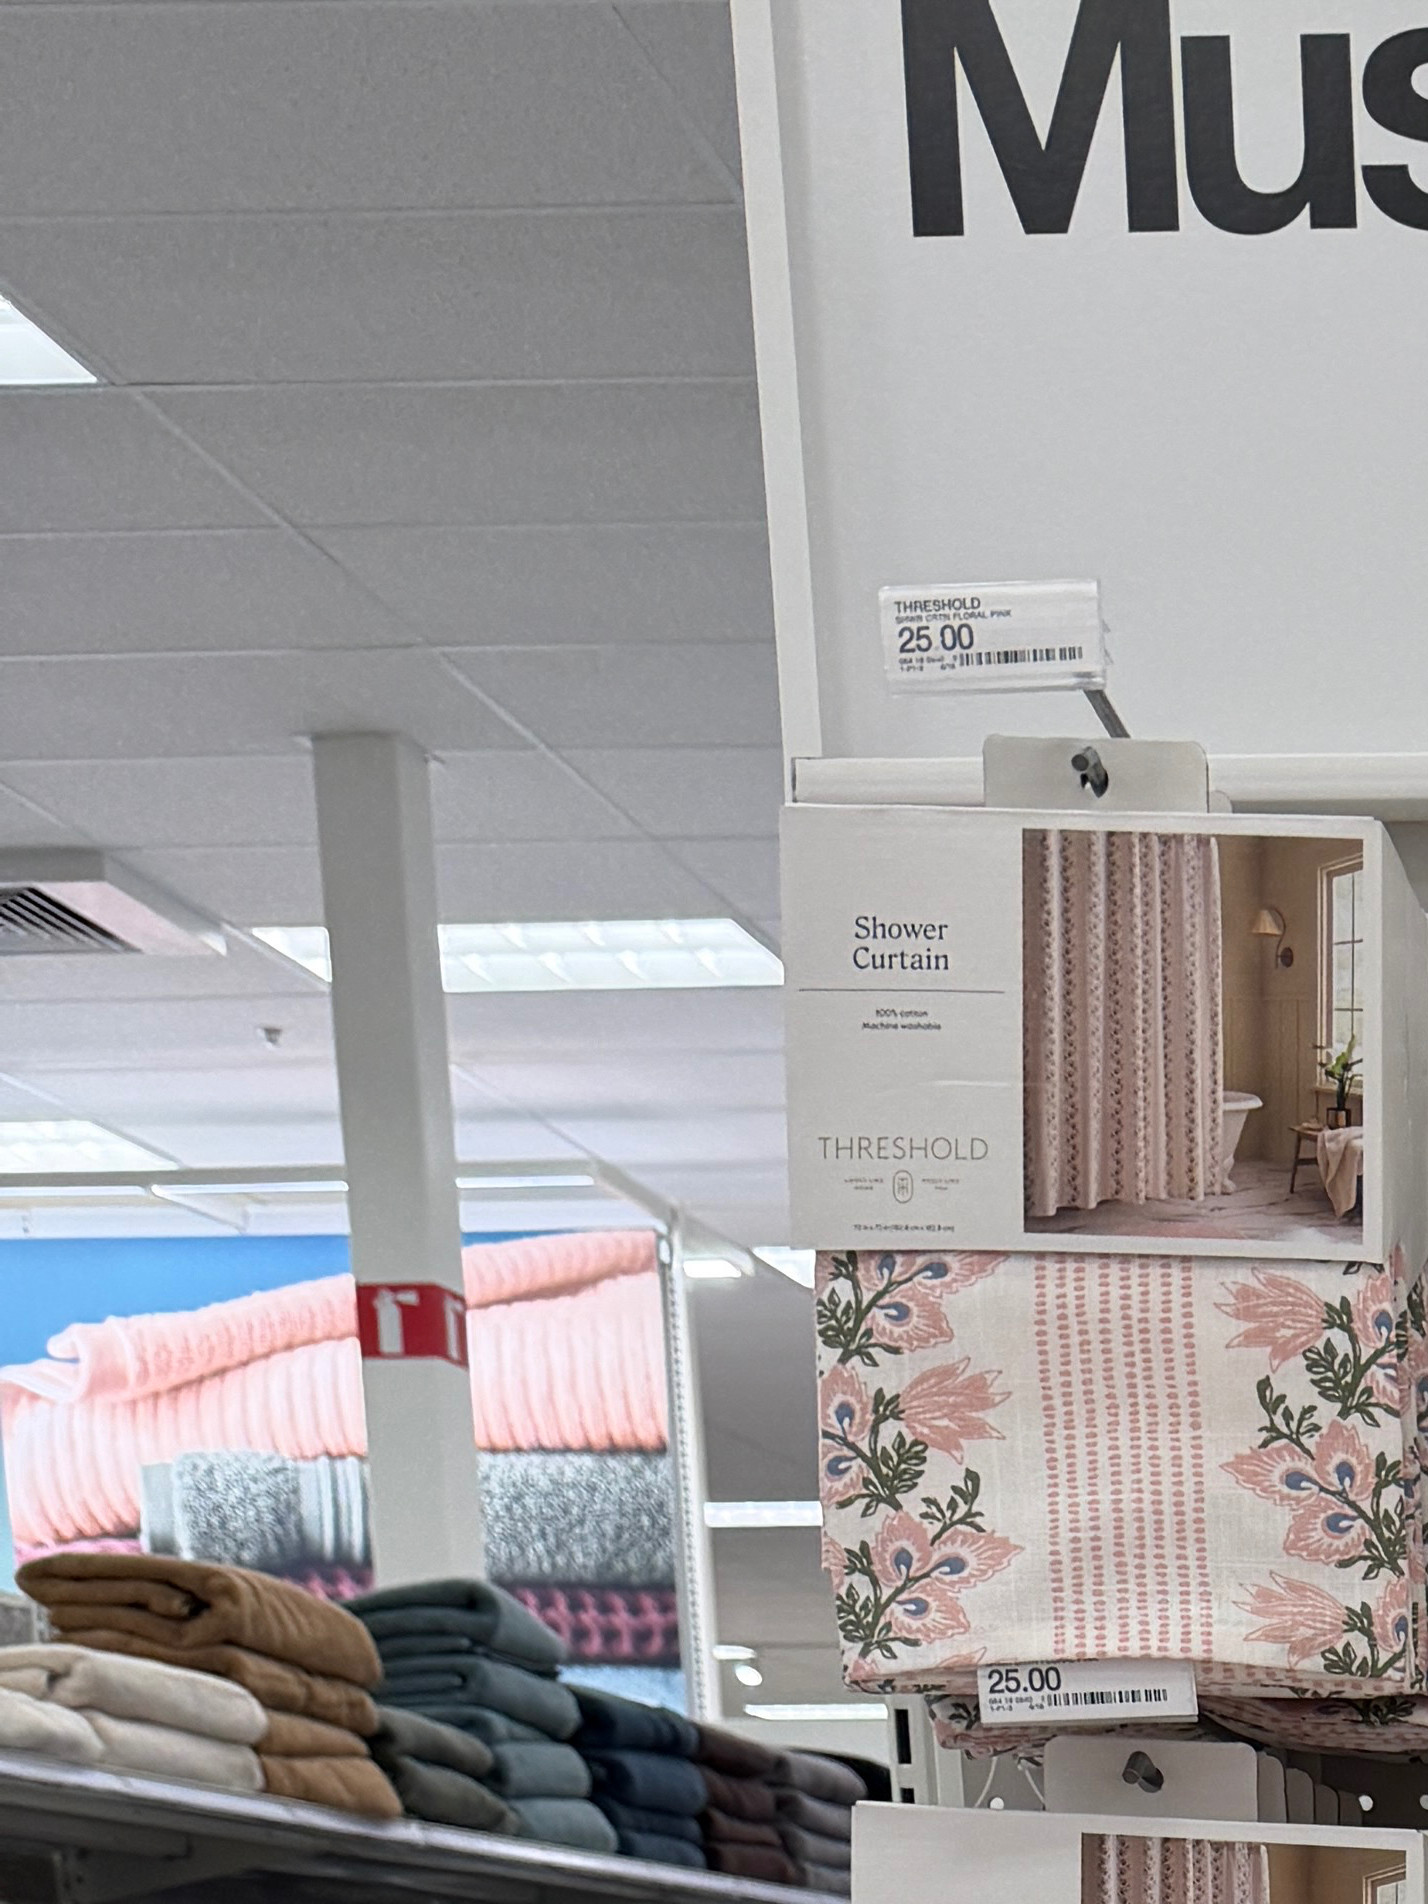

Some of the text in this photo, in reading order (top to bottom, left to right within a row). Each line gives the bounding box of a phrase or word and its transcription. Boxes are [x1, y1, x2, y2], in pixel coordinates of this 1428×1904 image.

[894, 597, 981, 613] THRESHOLD
[899, 623, 974, 653] 25.00
[854, 916, 948, 940] Shower
[853, 946, 949, 970] Curtain
[818, 1136, 989, 1160] THRESHOLD
[987, 1666, 1061, 1694] 25.00
